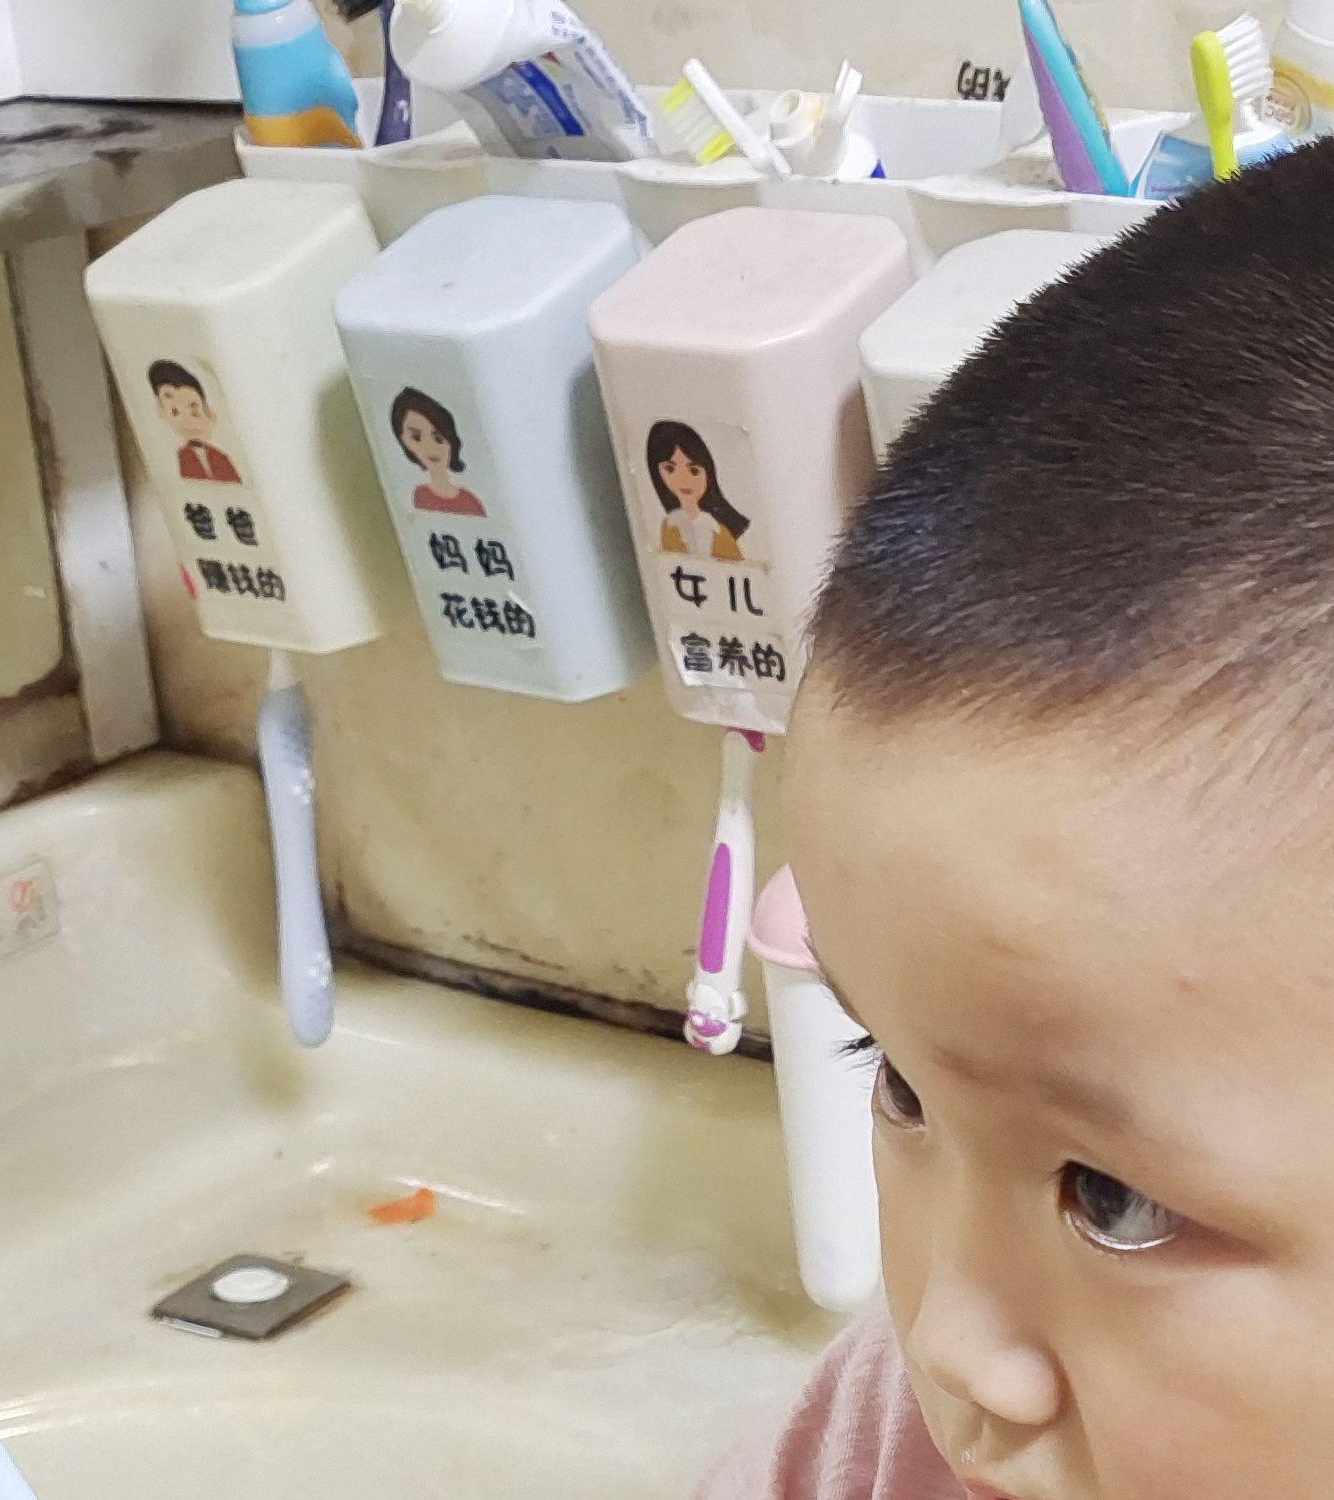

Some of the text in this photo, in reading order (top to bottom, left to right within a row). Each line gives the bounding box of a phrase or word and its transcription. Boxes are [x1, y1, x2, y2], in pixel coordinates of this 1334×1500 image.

[429, 532, 515, 581] 妈妈
[440, 592, 536, 638] 花钱的
[670, 565, 764, 616] 女儿
[680, 632, 786, 682] 富养的
